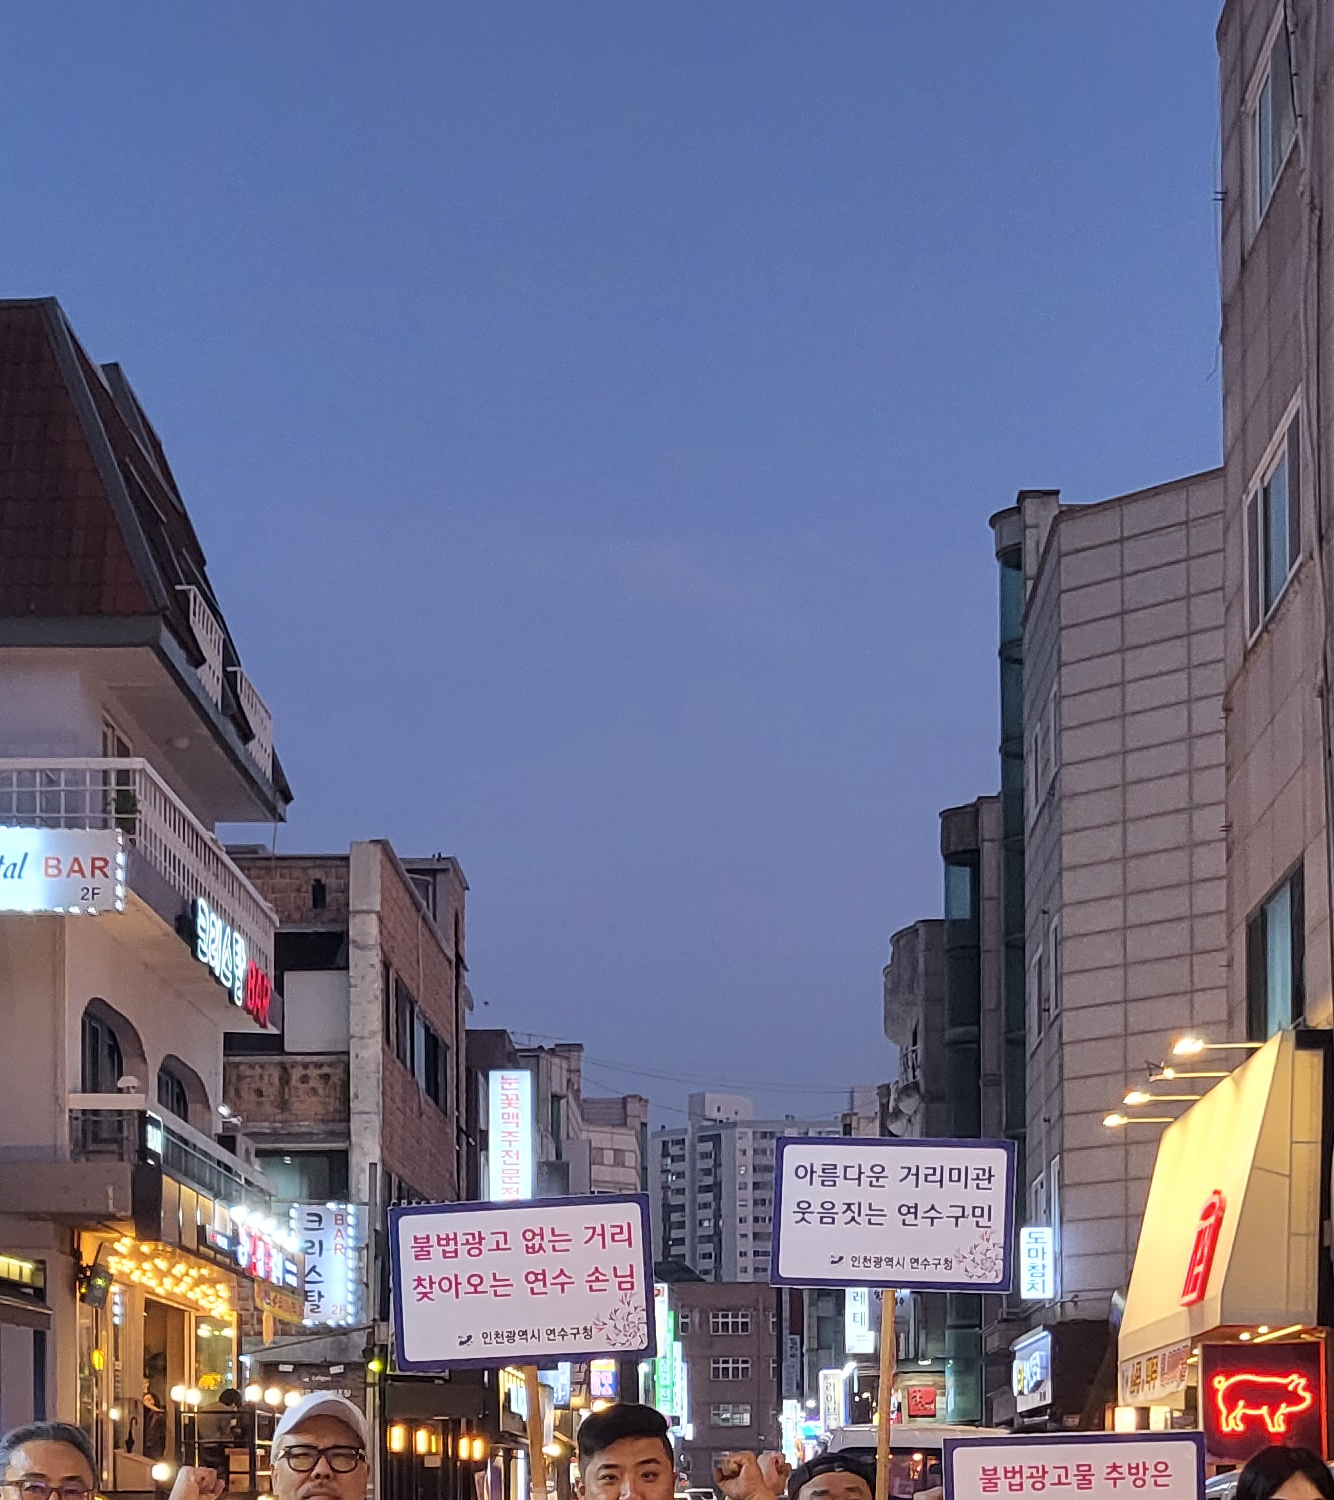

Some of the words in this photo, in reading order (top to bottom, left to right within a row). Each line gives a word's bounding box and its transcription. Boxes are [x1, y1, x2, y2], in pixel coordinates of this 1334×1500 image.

[44, 856, 110, 879] BAR
[80, 886, 102, 902] 2F
[793, 1162, 890, 1188] 아름다운
[898, 1164, 996, 1191] 거리미관
[792, 1200, 889, 1227] 웃음짓는
[896, 1202, 994, 1229] 연수구민
[334, 1213, 346, 1256] BAR
[410, 1230, 512, 1261] 불법광고
[521, 1226, 573, 1255] 없는
[584, 1221, 635, 1251] 거리
[303, 1212, 325, 1314] 크리스탈
[849, 1255, 906, 1271] 인천광역시
[909, 1256, 954, 1272] 연수구청
[1025, 1230, 1048, 1295] 도마참치
[412, 1272, 515, 1302] 찾아오는
[524, 1267, 576, 1297] 연수
[584, 1264, 636, 1294] 손님
[480, 1329, 542, 1347] 인천광역시
[544, 1326, 594, 1343] 연수구청
[978, 1462, 1095, 1493] 불법광고물
[1103, 1460, 1173, 1489] 추방은
